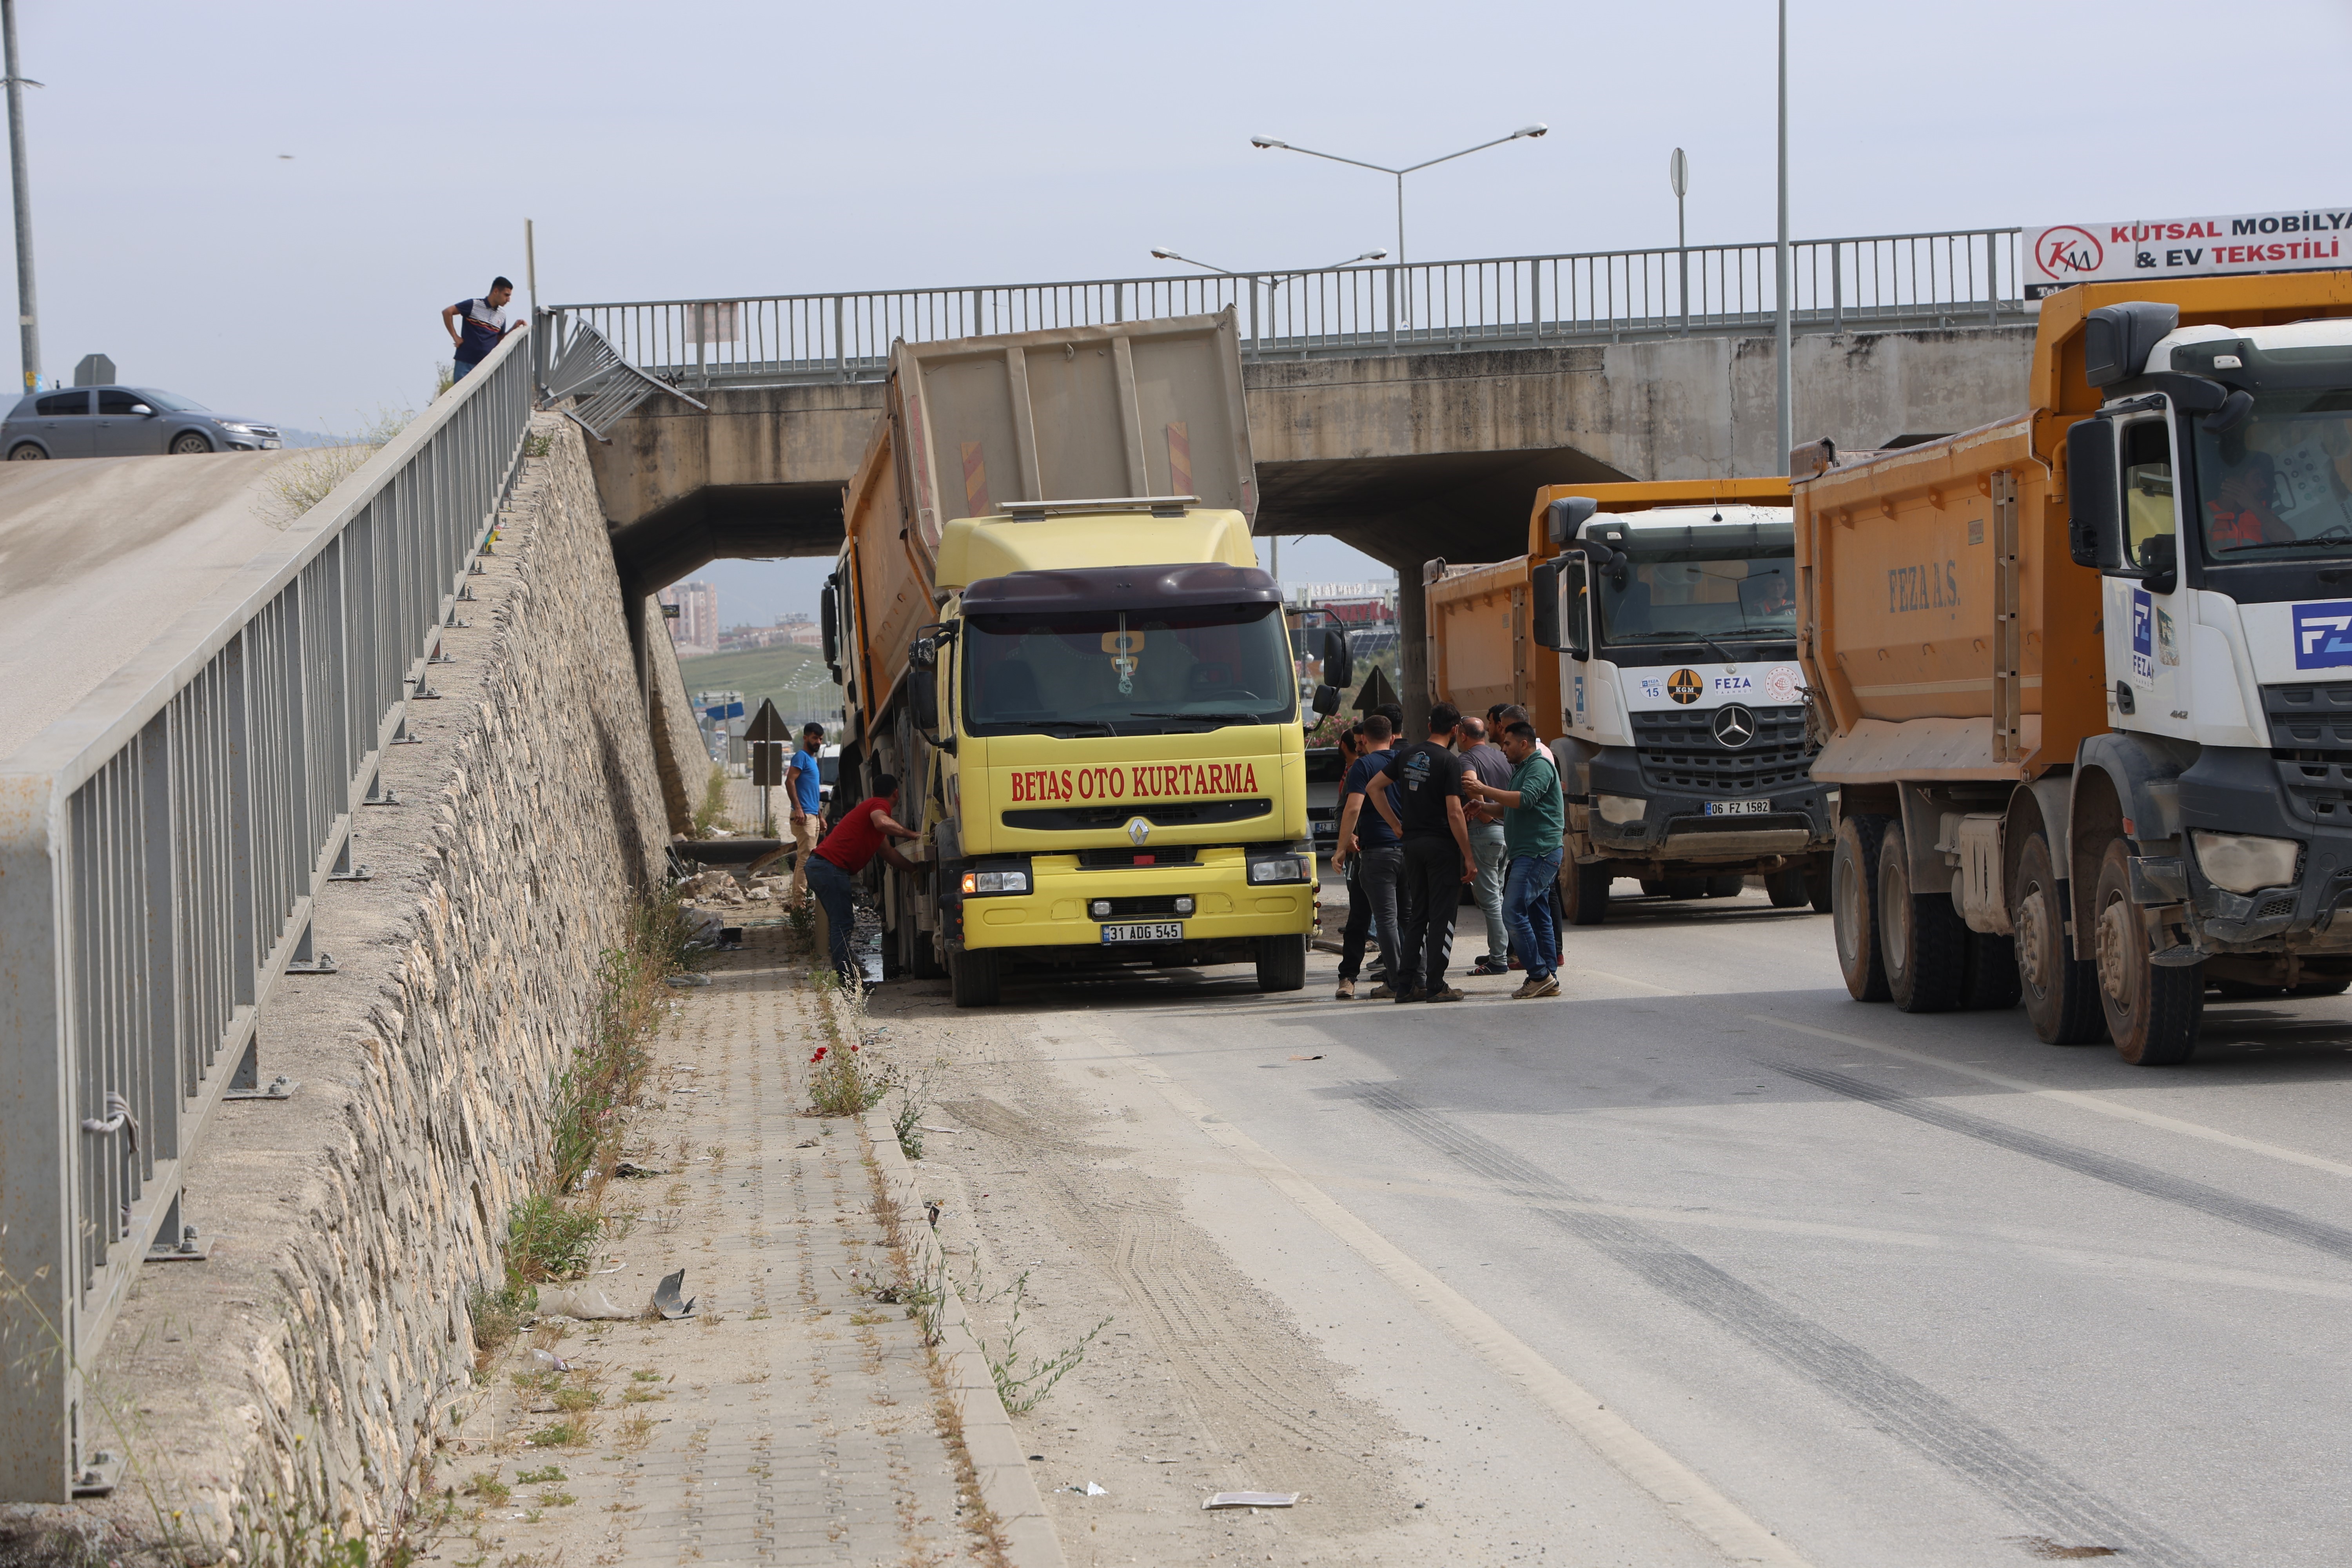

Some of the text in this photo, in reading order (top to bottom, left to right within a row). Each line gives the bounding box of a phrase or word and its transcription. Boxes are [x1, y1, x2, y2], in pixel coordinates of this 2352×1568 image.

[2111, 221, 2222, 243] KUTSAL
[2137, 236, 2338, 268] & EV TEKSTİLİ
[1888, 564, 1929, 613] FEZA
[2133, 655, 2152, 679] FEZA
[1646, 688, 1659, 697] 15
[1715, 677, 1751, 689] FEZA
[1011, 763, 1258, 802] BETAŞ OTO KURTARMA
[1712, 802, 1768, 814] 06 FZ 1582
[1111, 925, 1178, 940] 31 ADG 545
